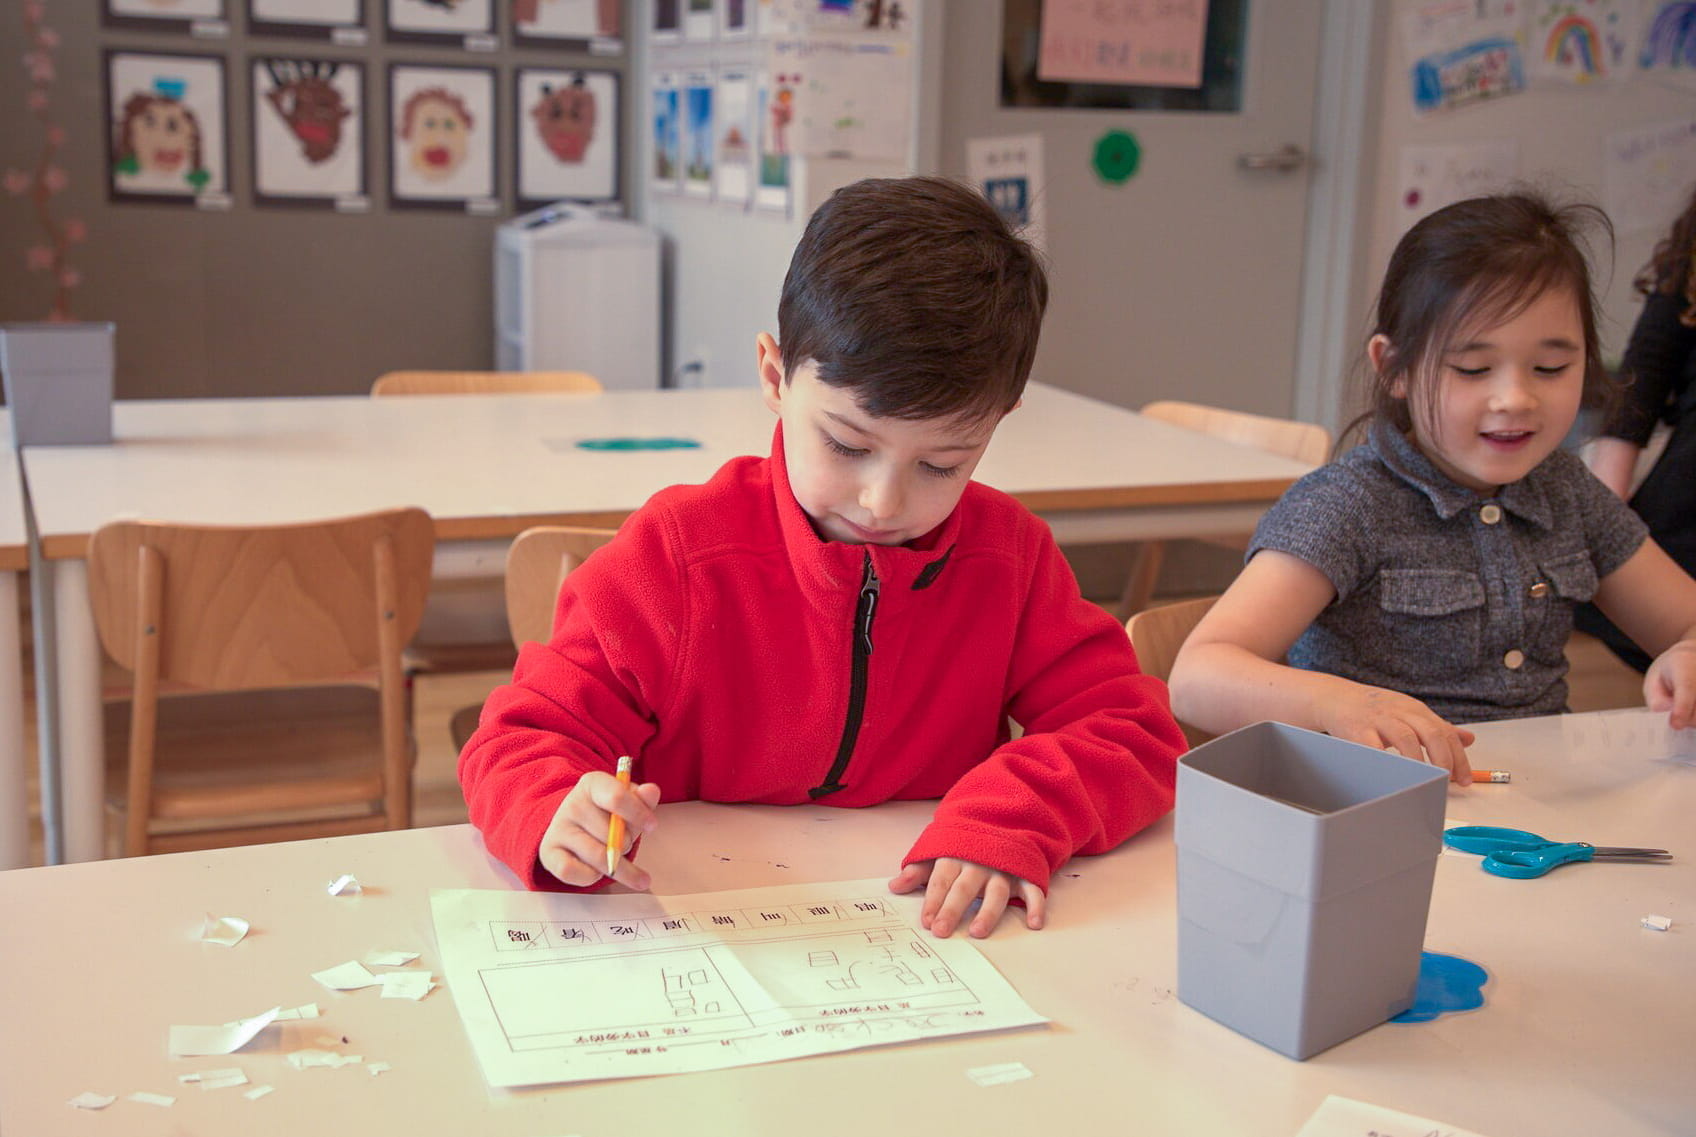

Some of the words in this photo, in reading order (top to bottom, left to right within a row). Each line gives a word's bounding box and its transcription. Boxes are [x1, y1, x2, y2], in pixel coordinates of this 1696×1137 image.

[507, 929, 531, 942] 喝
[560, 928, 584, 940] 看
[609, 925, 635, 936] 吃
